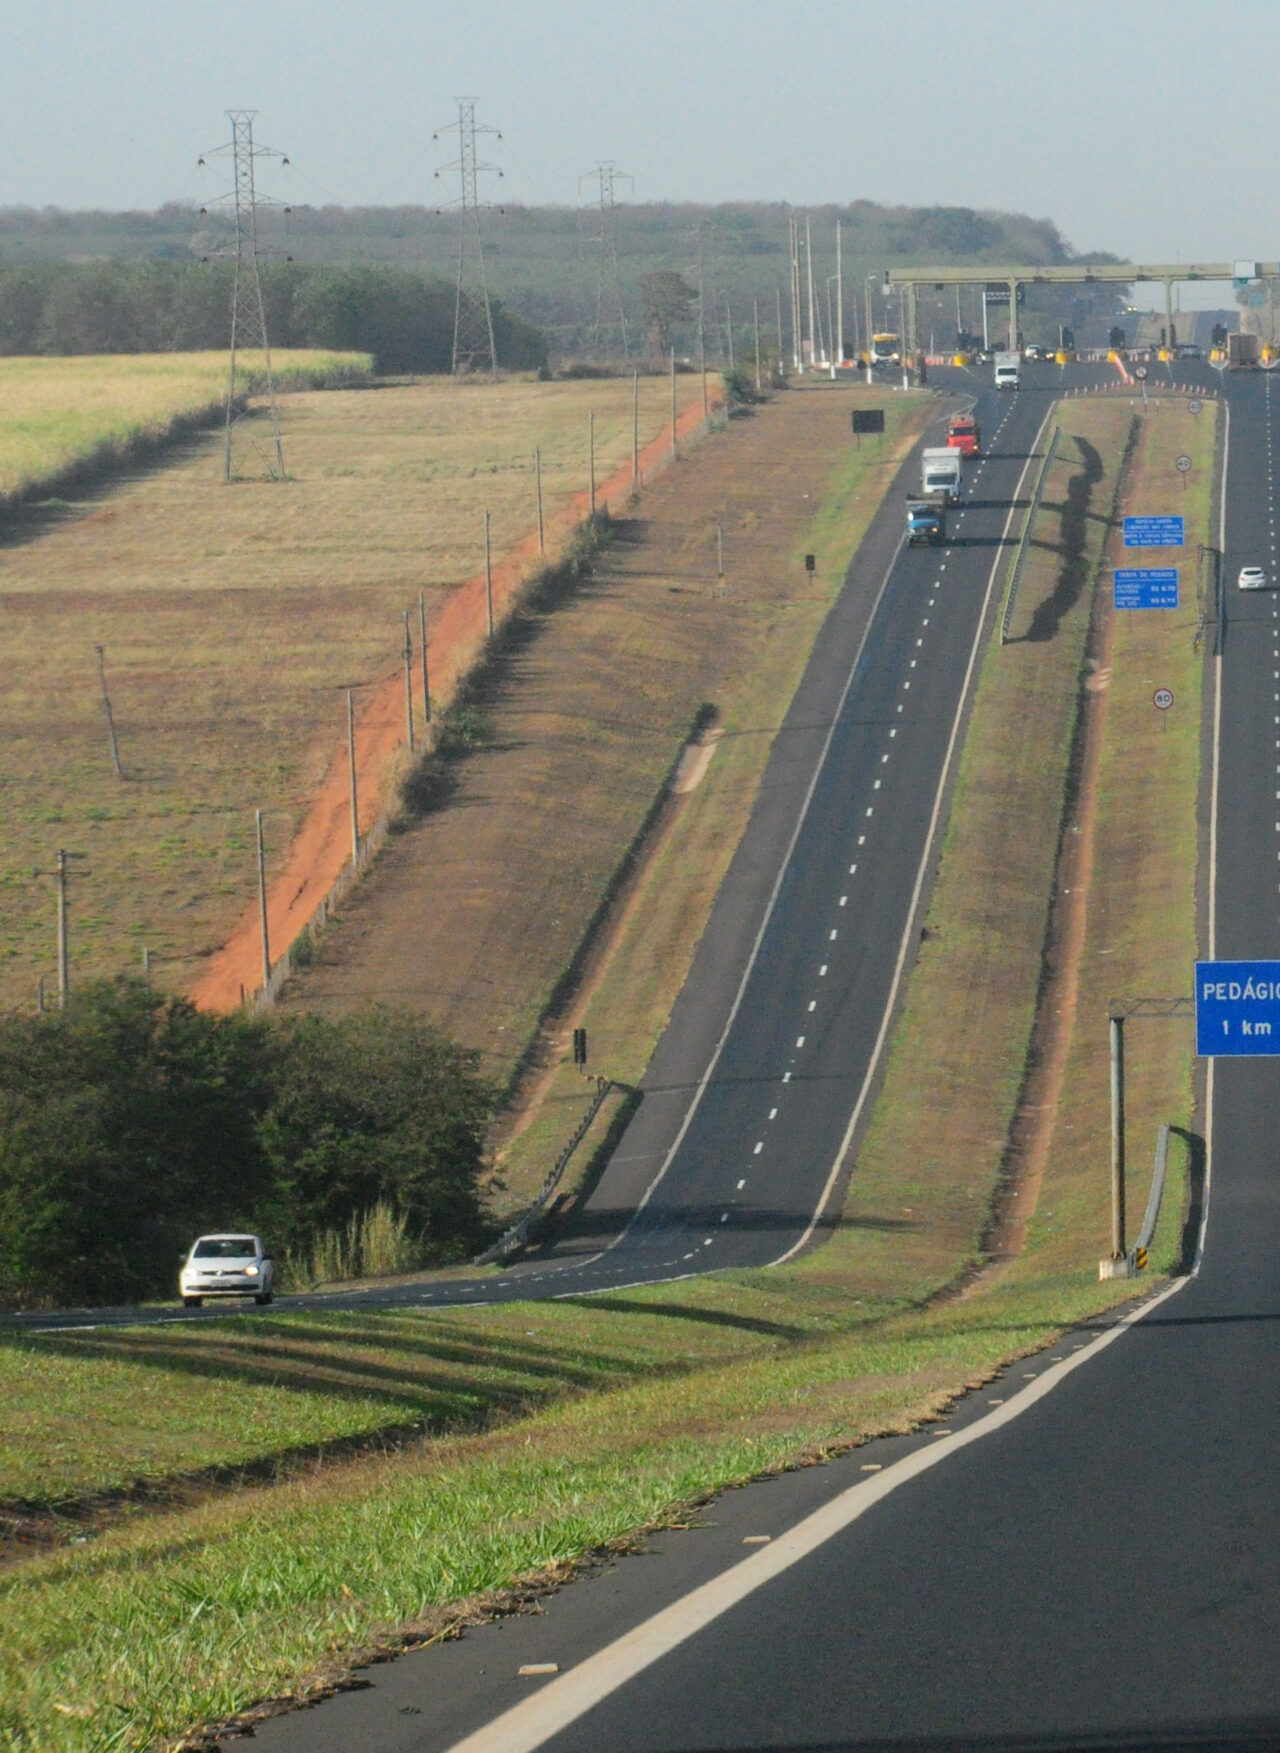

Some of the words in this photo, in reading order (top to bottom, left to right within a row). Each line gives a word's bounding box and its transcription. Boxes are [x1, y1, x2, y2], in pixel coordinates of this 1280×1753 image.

[1156, 694, 1170, 702] 80
[1222, 1019, 1229, 1035] 1
[1242, 1019, 1272, 1035] km
